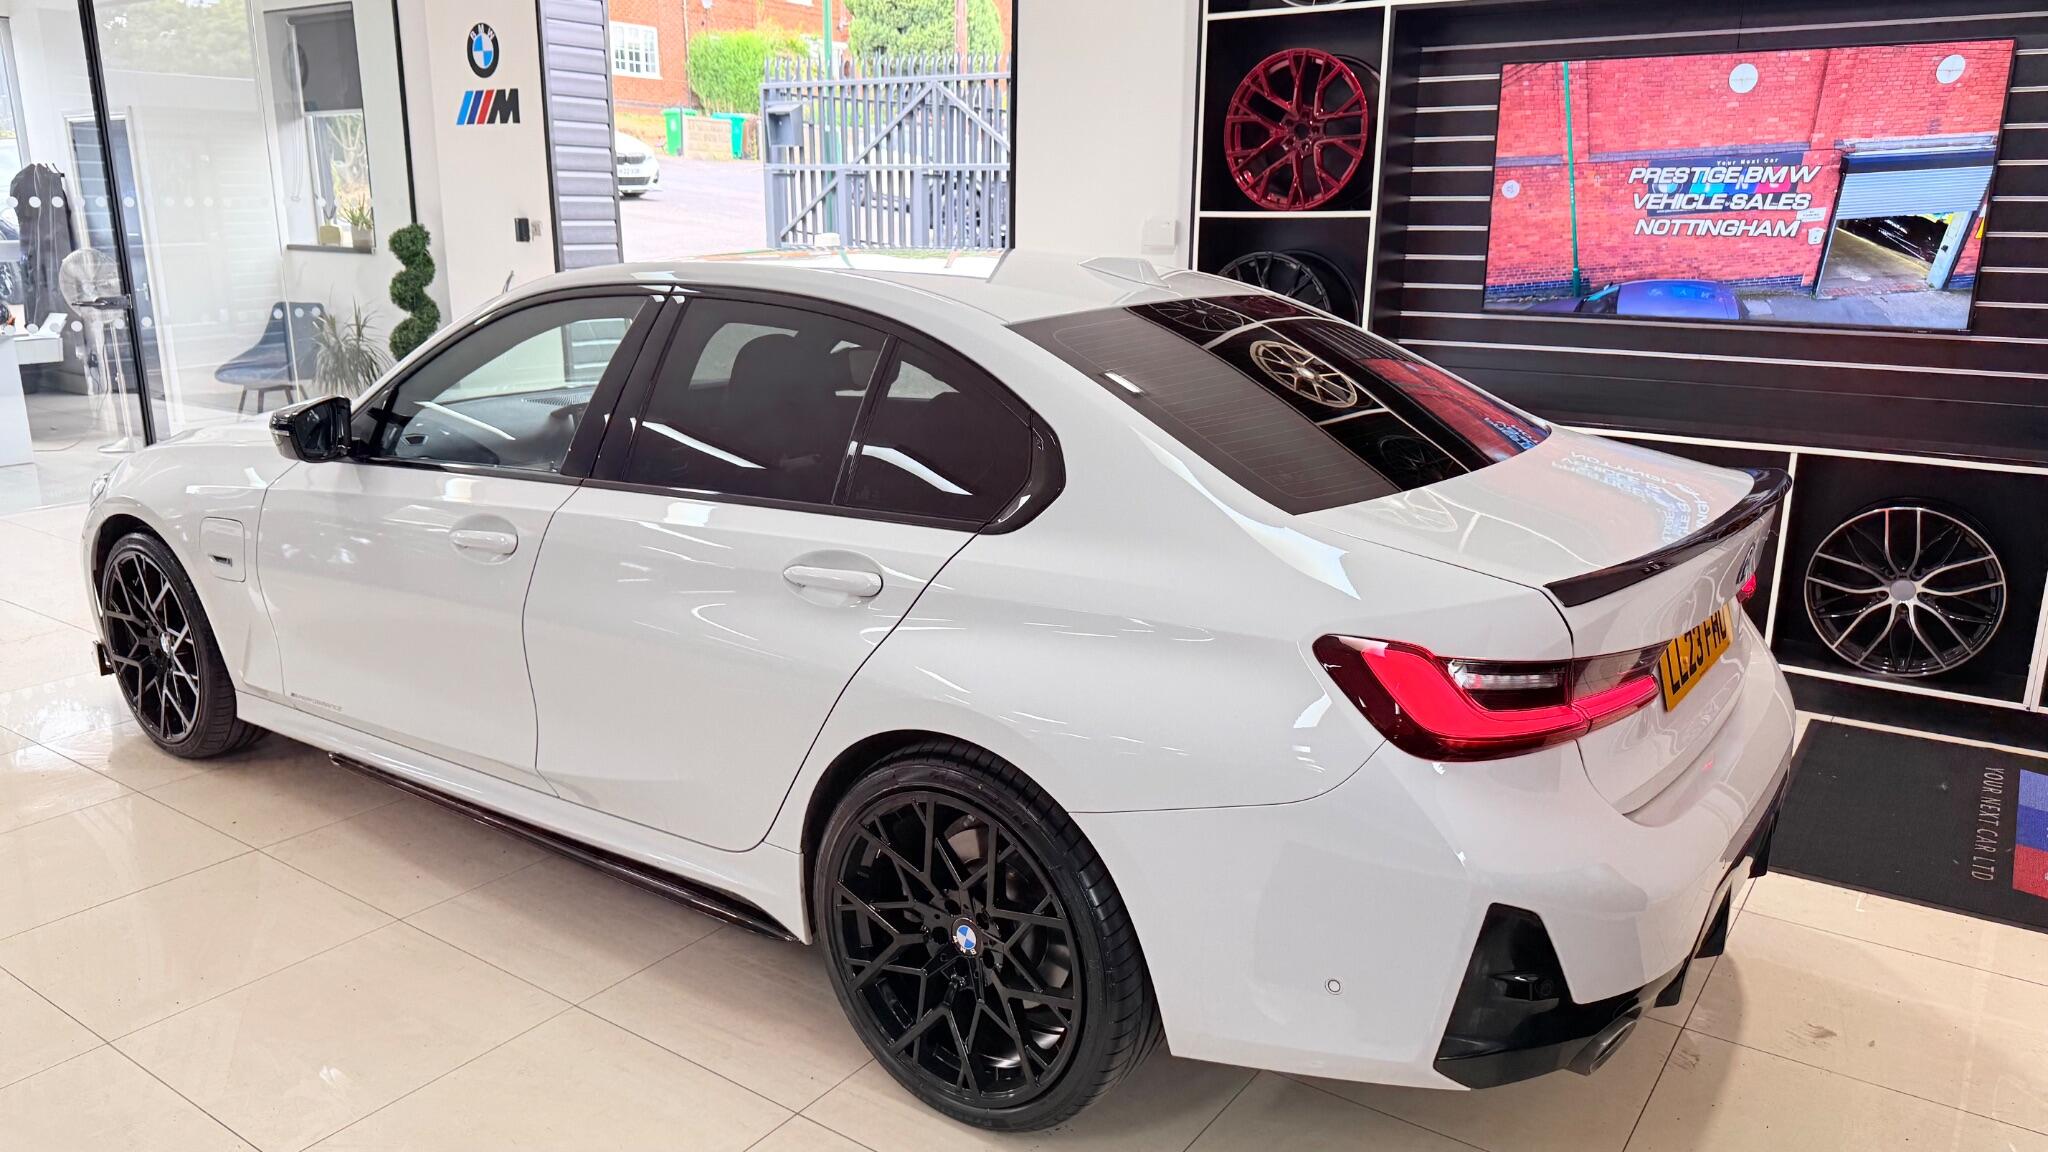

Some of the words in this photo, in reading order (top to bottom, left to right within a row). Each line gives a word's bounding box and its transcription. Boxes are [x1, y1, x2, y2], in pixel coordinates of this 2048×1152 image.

[469, 23, 496, 41] BMW
[1628, 165, 1741, 185] PRESTIGE
[1743, 164, 1822, 184] BMW
[1633, 193, 1727, 210] VEHICLE
[1729, 192, 1812, 211] SALES
[1634, 218, 1801, 237] NOTTINGHAM
[1666, 627, 1704, 695] LL23
[1982, 767, 2004, 795] YOUR
[1979, 796, 2001, 826] NEXT
[1975, 828, 1998, 853] CAR
[1971, 855, 1995, 881] LTD
